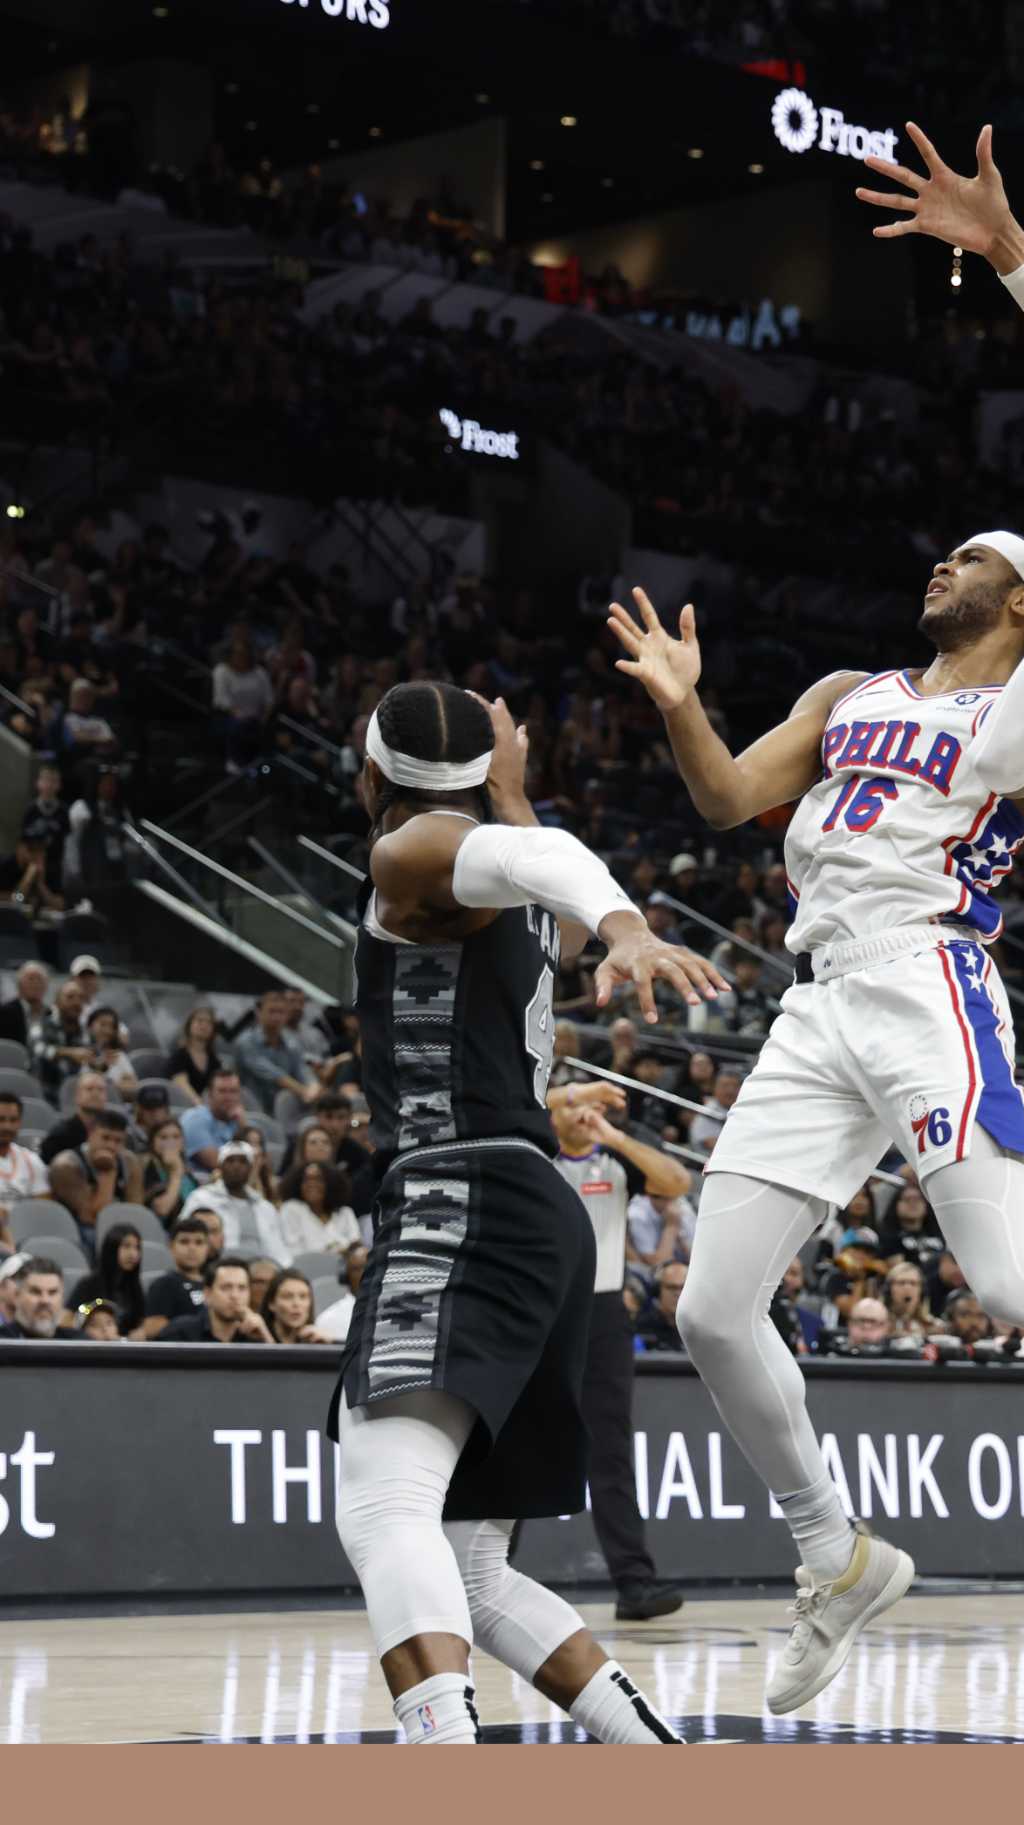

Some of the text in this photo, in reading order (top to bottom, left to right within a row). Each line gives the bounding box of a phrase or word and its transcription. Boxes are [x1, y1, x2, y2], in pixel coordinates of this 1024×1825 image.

[823, 720, 962, 798] PHILA
[821, 774, 900, 833] 16
[910, 1107, 953, 1154] 76
[213, 1429, 341, 1524] TH
[769, 1433, 950, 1519] ANK
